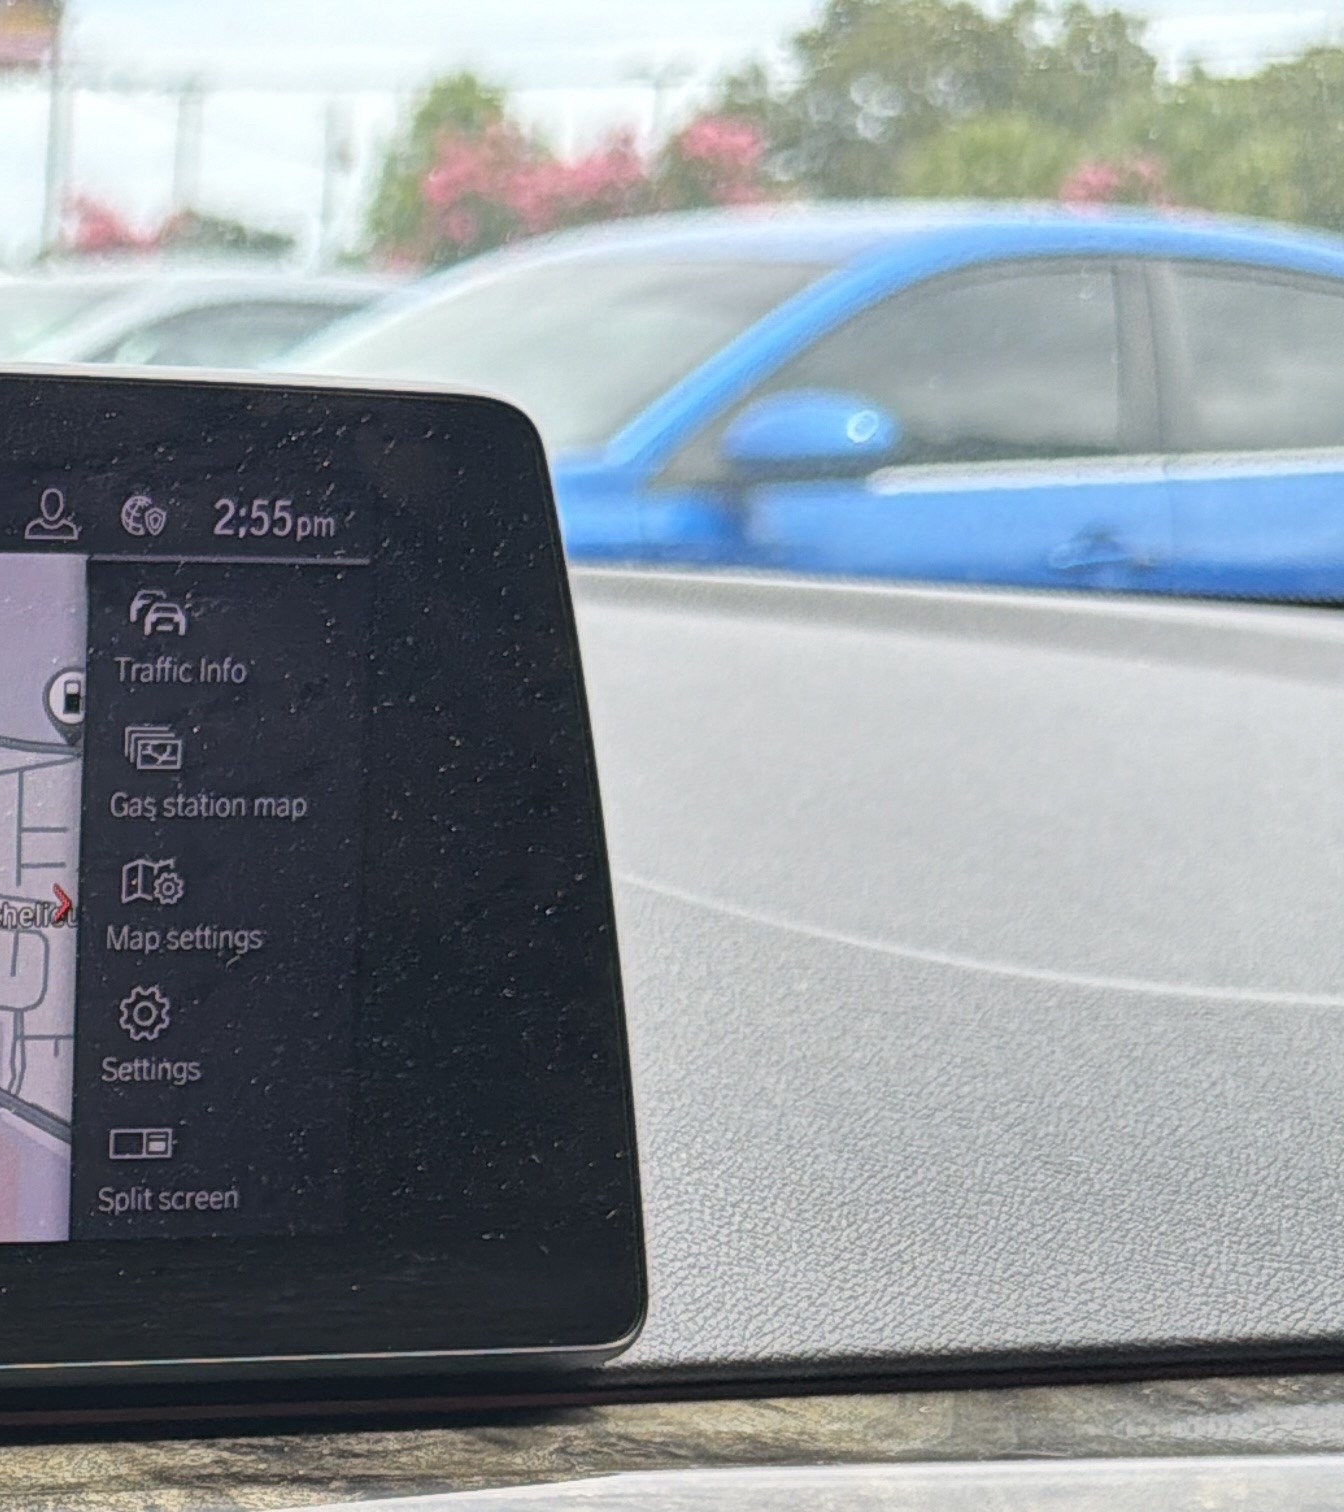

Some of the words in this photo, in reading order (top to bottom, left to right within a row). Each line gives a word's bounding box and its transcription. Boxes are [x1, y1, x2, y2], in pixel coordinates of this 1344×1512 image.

[115, 656, 192, 683] Traffic
[201, 658, 247, 684] Info
[110, 793, 156, 820] Gas
[163, 793, 247, 819] station
[254, 797, 307, 822] map
[106, 927, 160, 953] Map
[167, 927, 263, 954] settings
[101, 1058, 201, 1085] Settings
[99, 1188, 152, 1215] Split
[158, 1188, 239, 1211] screen
